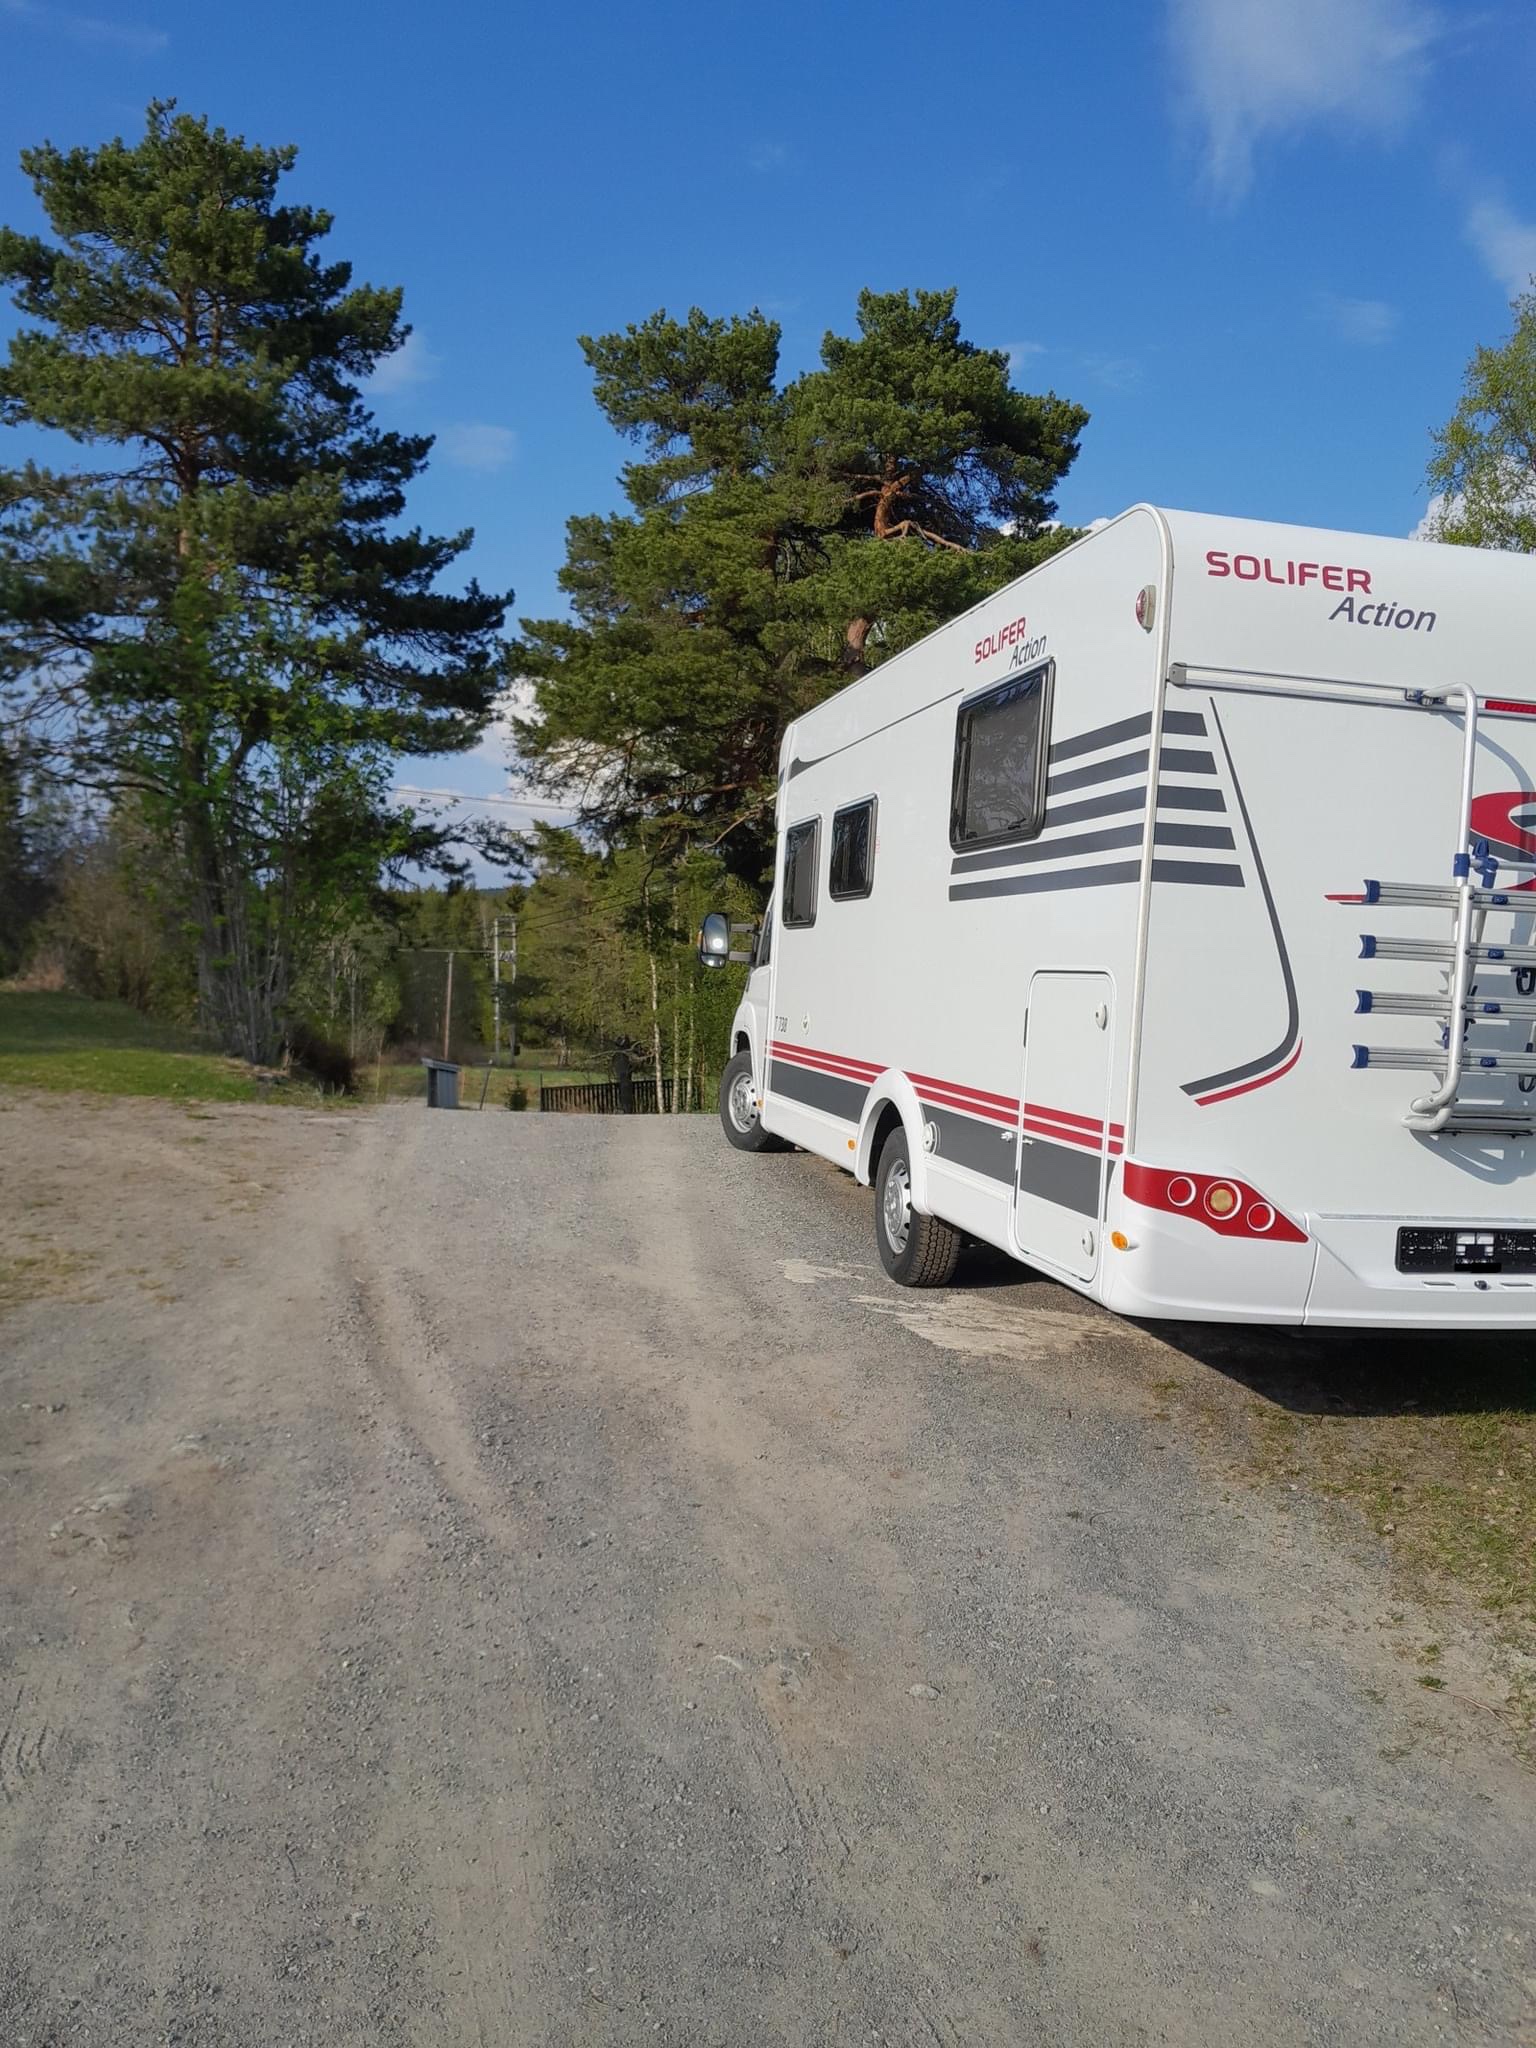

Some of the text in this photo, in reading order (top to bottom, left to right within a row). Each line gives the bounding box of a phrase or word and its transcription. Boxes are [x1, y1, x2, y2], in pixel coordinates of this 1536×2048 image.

[1206, 550, 1373, 594] SOLIFER
[1328, 596, 1437, 633] Action
[974, 616, 1027, 665] SOLIFER
[1009, 635, 1047, 670] Action
